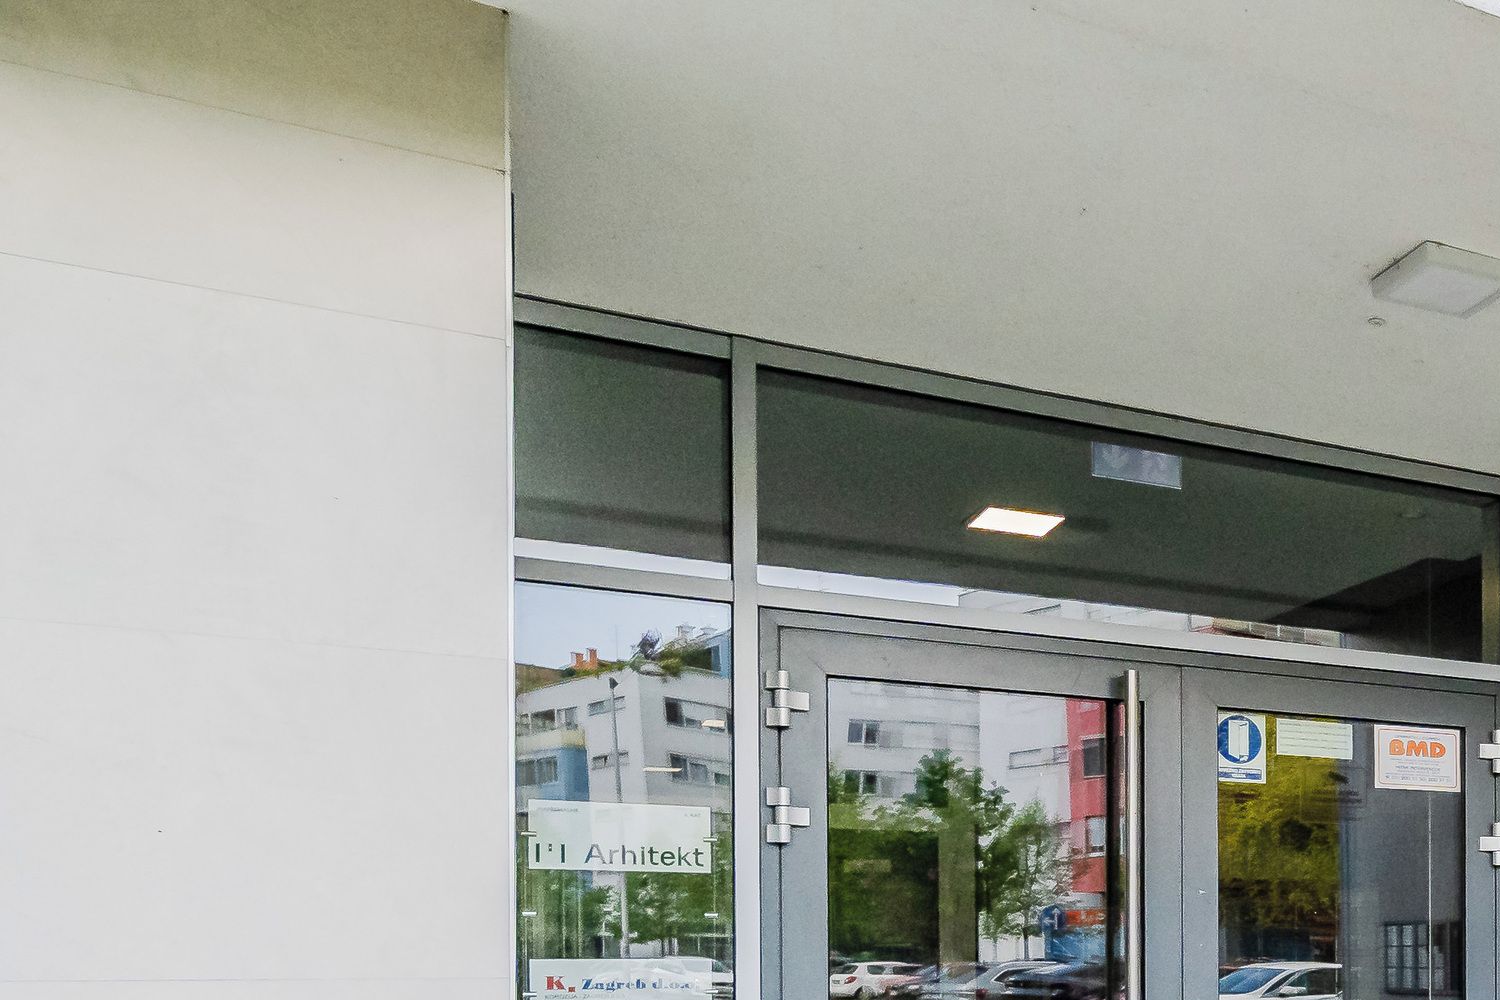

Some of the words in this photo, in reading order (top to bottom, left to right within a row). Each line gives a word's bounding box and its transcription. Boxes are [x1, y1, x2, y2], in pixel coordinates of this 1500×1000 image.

[1389, 739, 1446, 758] BMD
[584, 843, 704, 867] Arhitekt
[581, 978, 647, 992] Zagreb
